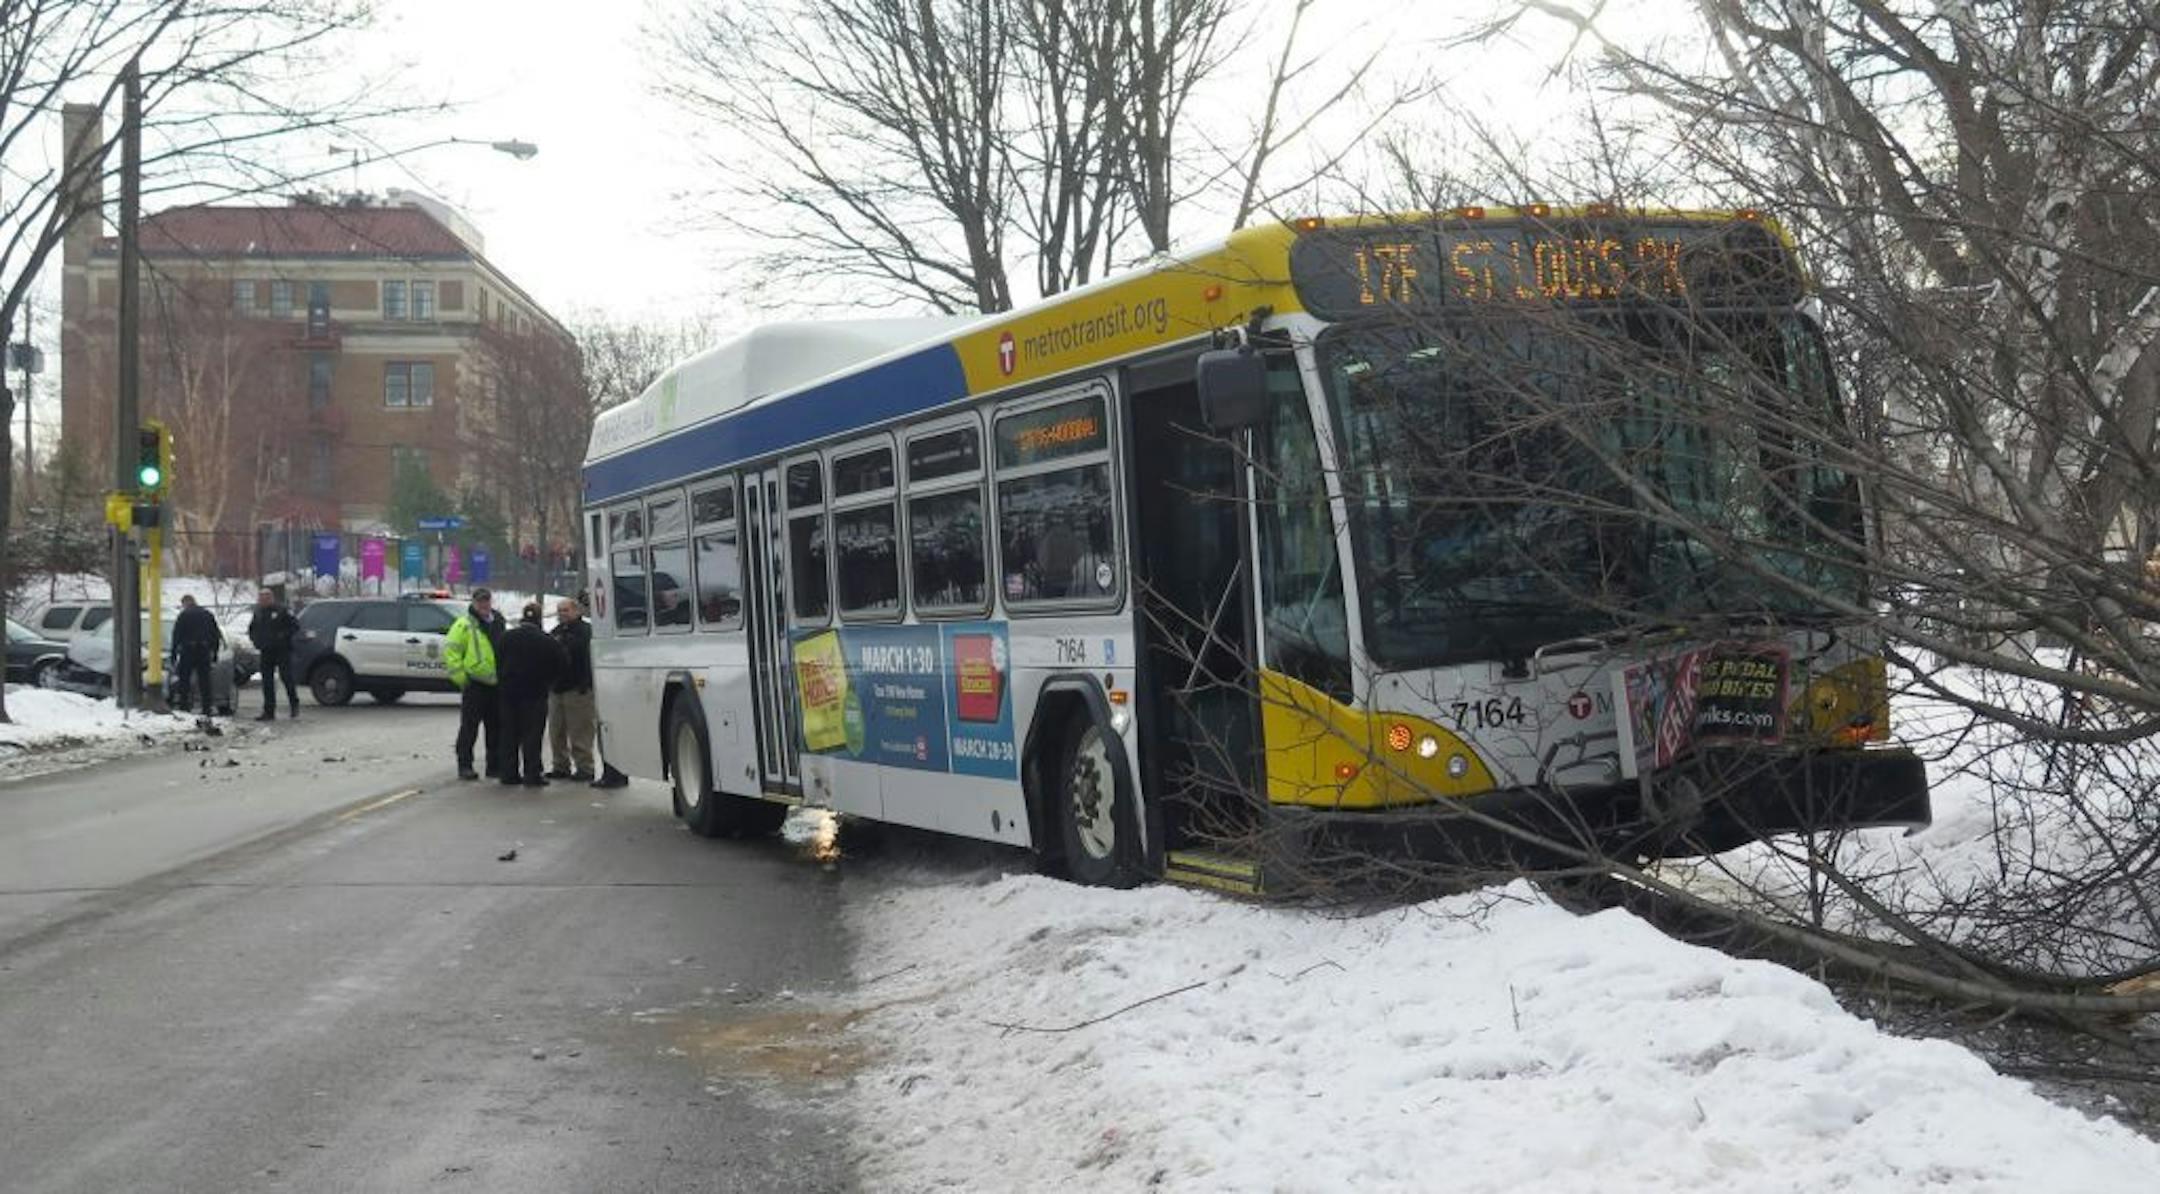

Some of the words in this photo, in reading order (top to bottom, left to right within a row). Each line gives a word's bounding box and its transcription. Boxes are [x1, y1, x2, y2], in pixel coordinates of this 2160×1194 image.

[1355, 244, 1417, 304] 17F
[1451, 240, 1495, 299] ST
[1510, 237, 1626, 298] LOUIS
[1024, 298, 1168, 361] metrotransit.org
[407, 660, 448, 671] POLIC
[862, 645, 904, 674] MARCH
[906, 646, 934, 674] 1-30
[1057, 638, 1087, 664] 7164
[1451, 696, 1525, 730] 7164
[952, 736, 987, 758] MARCH
